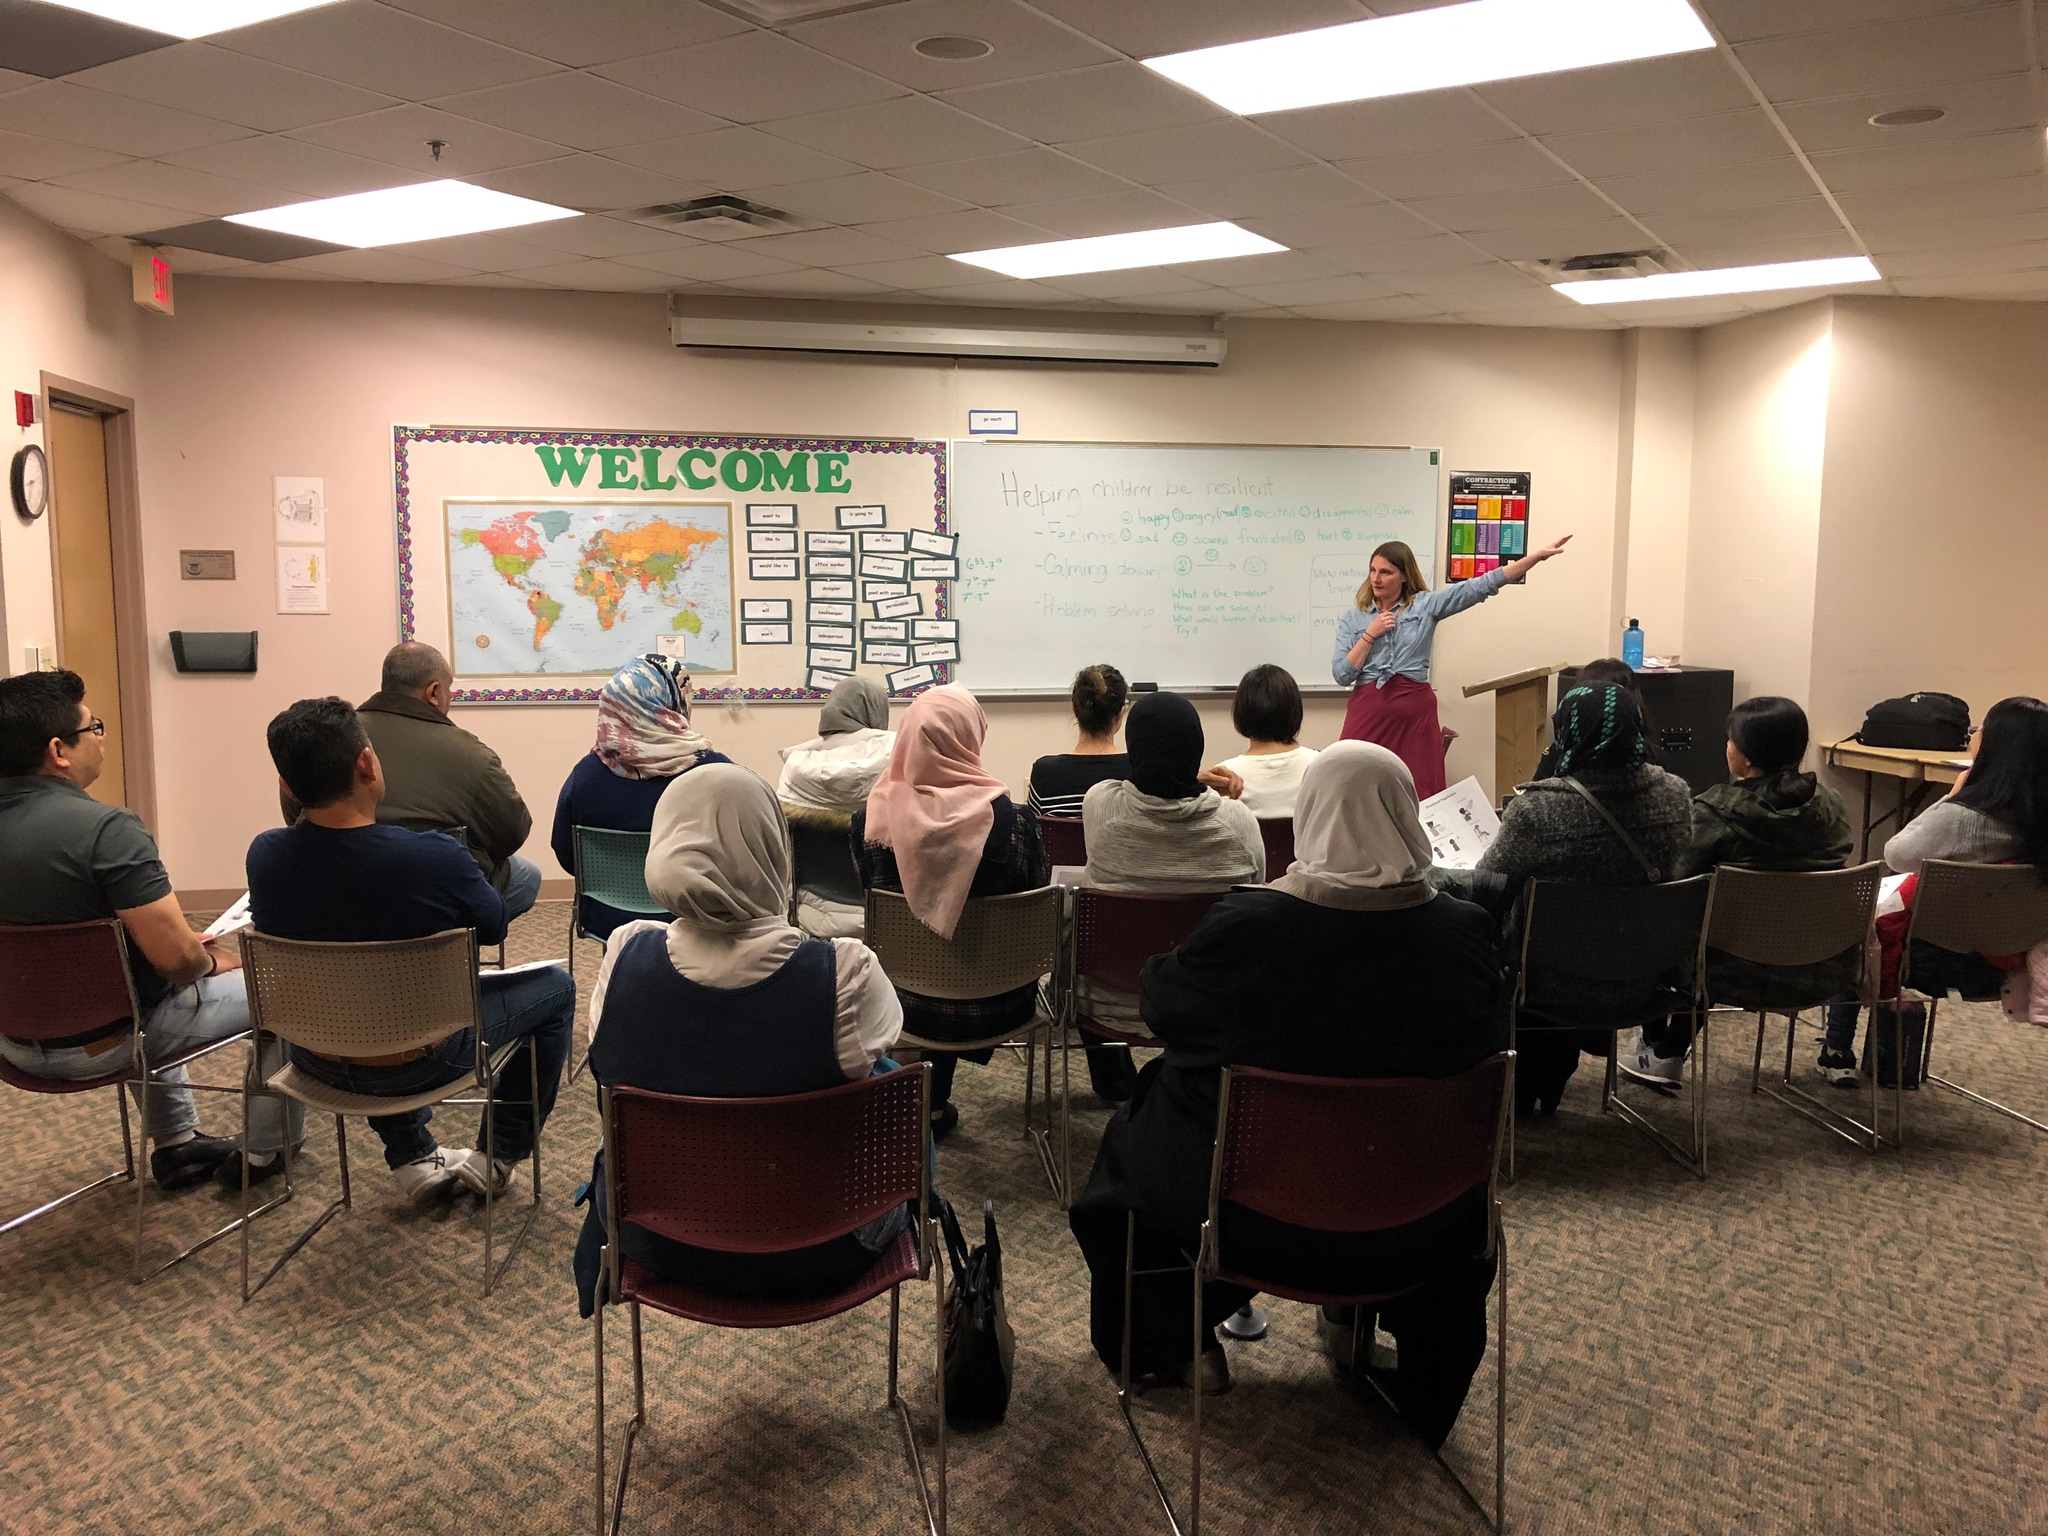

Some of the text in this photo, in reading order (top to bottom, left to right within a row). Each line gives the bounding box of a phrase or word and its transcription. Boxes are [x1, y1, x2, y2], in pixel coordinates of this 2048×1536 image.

[535, 445, 852, 493] WELCOME
[1001, 470, 1274, 518] Helping children be resilient
[1137, 509, 1170, 530] happy
[1254, 506, 1295, 519] excited
[1391, 507, 1414, 515] calm
[1134, 531, 1158, 543] sad
[1193, 534, 1228, 545] scared
[1317, 528, 1338, 540] hurt
[1171, 589, 1197, 599] What
[1214, 588, 1229, 598] the
[1173, 602, 1192, 611] How
[1230, 604, 1250, 612] solve
[1107, 604, 1156, 629] solving
[1174, 624, 1190, 639] Try
[1638, 1055, 1649, 1068] N
